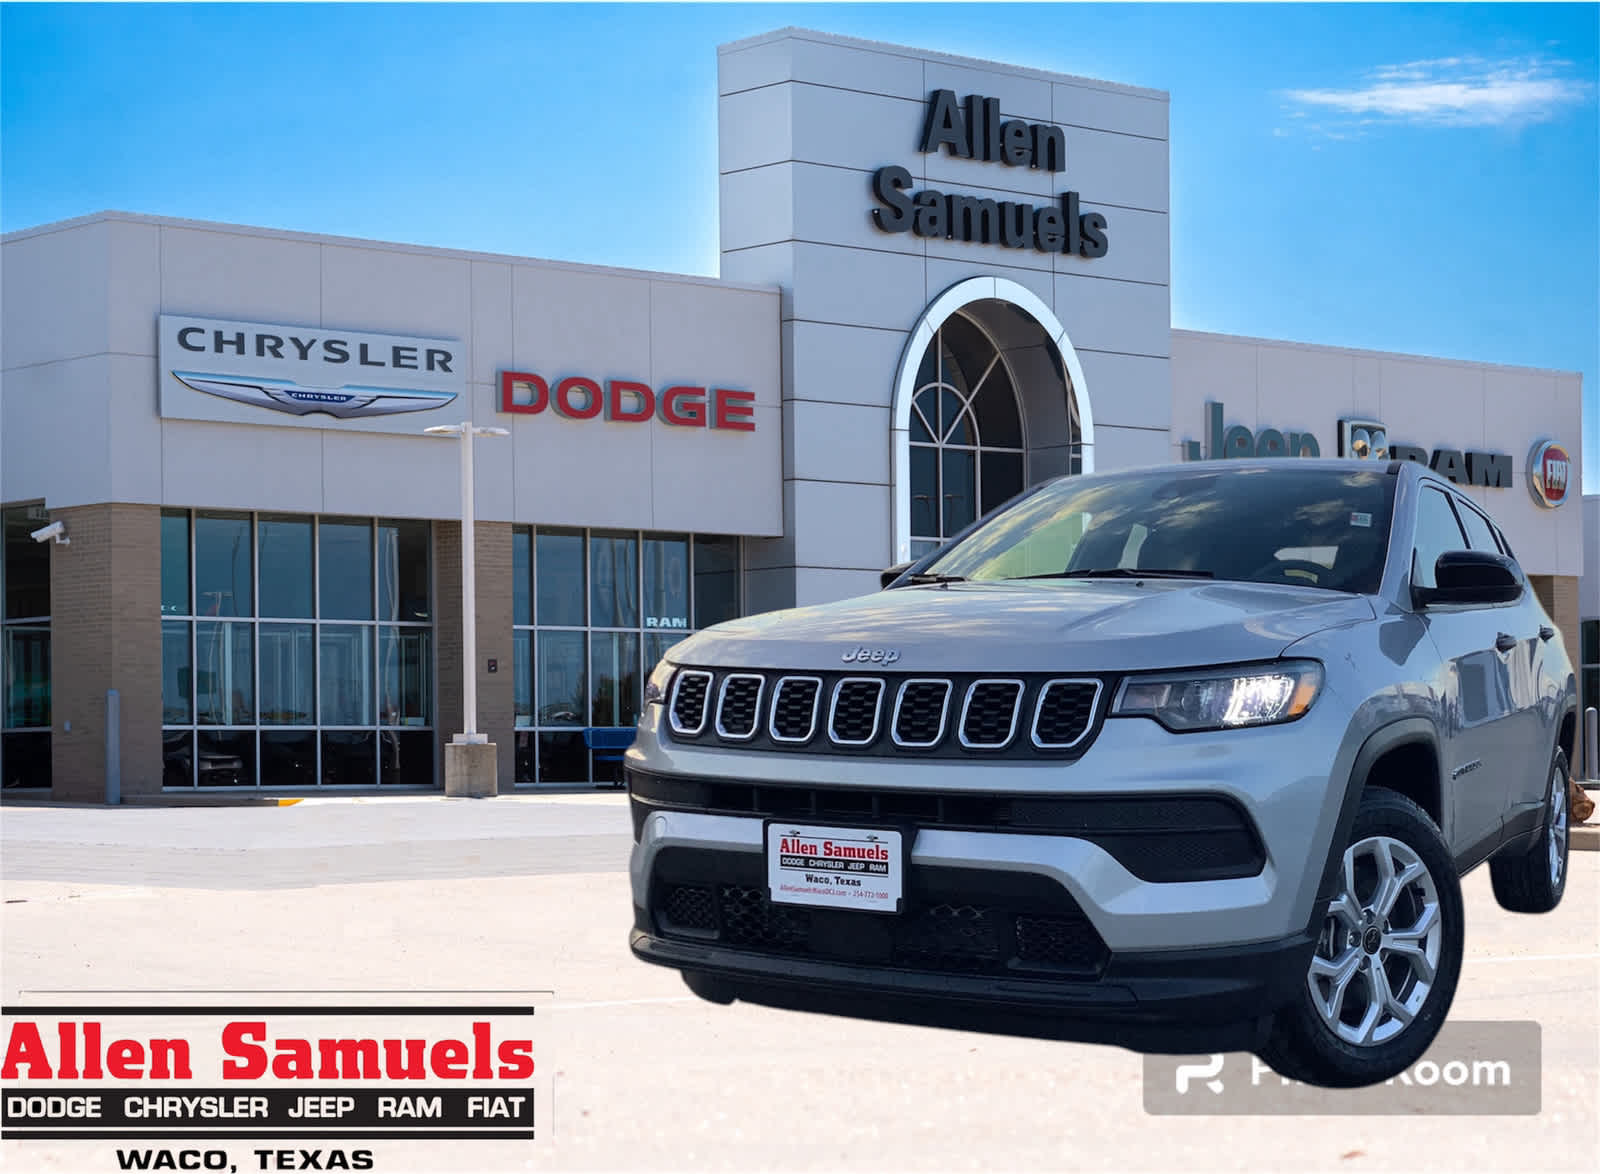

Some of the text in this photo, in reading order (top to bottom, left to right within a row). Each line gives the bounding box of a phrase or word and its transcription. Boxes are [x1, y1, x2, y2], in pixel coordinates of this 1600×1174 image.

[919, 89, 1066, 172] Allen
[872, 165, 1109, 258] Samuels
[177, 327, 454, 373] CHRYSLER
[291, 392, 346, 401] CHRYSLER
[496, 370, 756, 432] DODGE
[1546, 458, 1567, 490] FIAT
[646, 616, 688, 628] RAM
[841, 646, 901, 667] Jeep
[780, 838, 889, 860] Allen Samuels
[782, 857, 887, 872] DODGE CHRYSLER JEEP RAM
[805, 873, 861, 887] Waco, Texas
